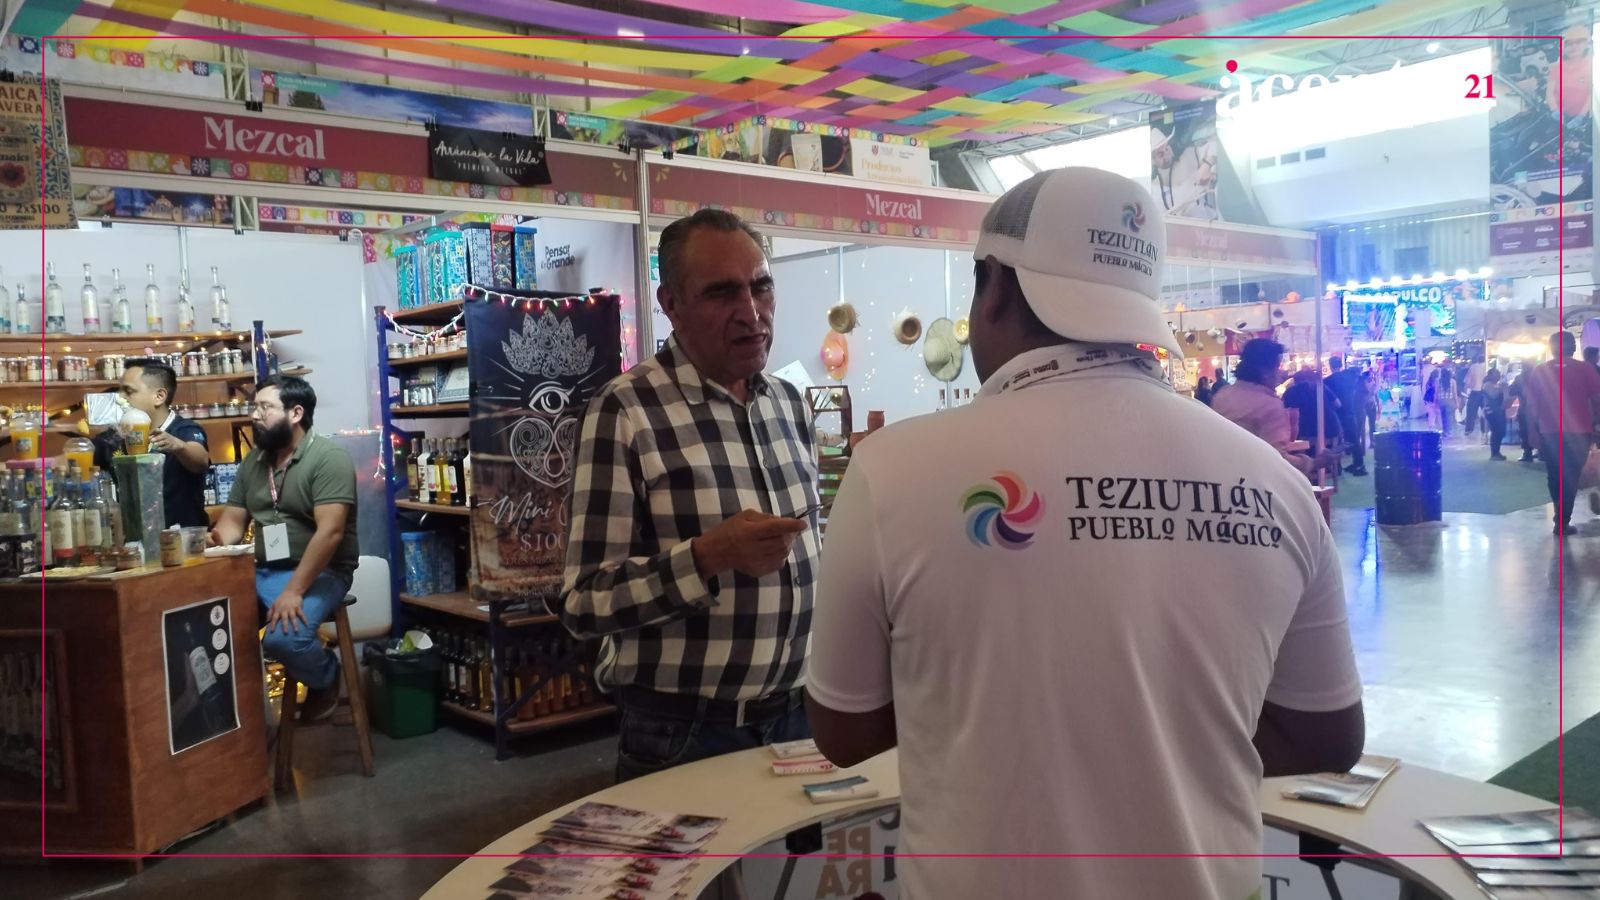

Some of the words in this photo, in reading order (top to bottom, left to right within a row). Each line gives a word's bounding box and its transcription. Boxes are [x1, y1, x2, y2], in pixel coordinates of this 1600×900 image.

[203, 116, 326, 160] Mezcal
[499, 147, 513, 162] la
[515, 148, 540, 165] Vida
[865, 192, 922, 220] Mezcal
[545, 245, 571, 258] Pensar
[546, 254, 576, 270] Grande
[489, 492, 554, 535] Mini
